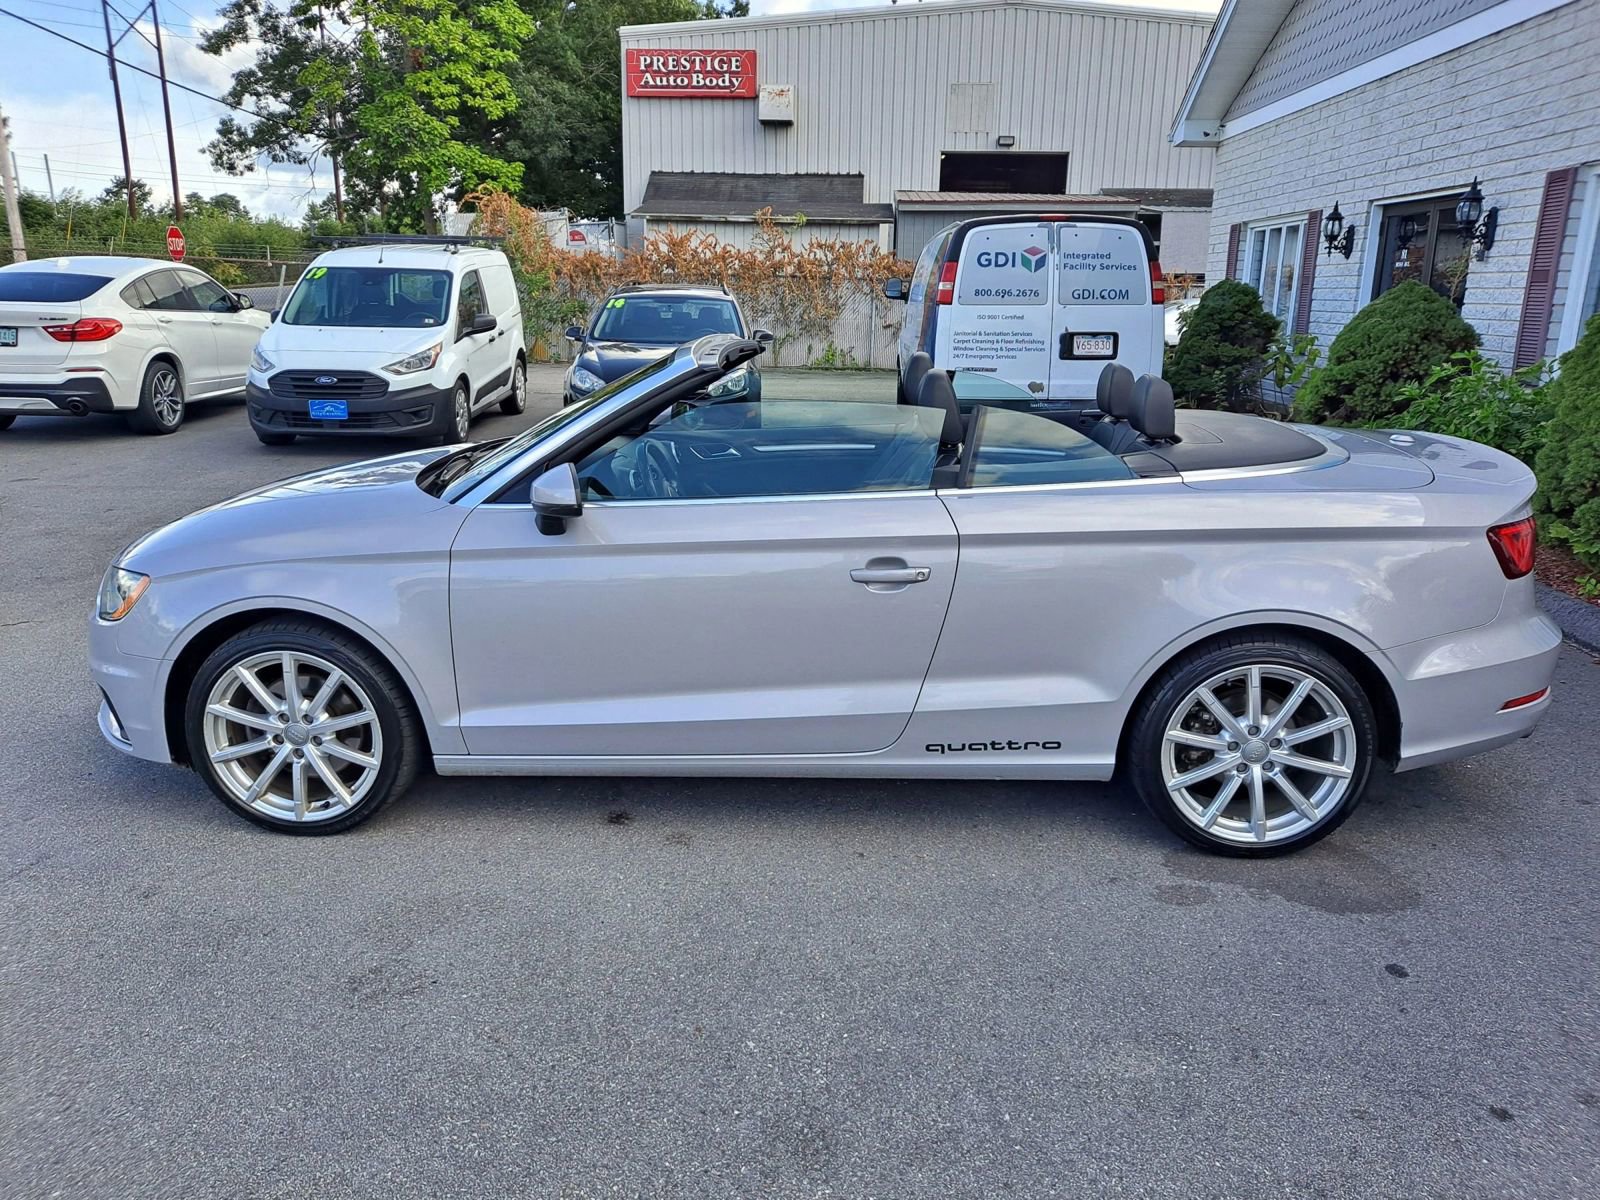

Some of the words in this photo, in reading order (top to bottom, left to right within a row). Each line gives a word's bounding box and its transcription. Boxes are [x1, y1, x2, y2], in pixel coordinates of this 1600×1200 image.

[639, 55, 742, 73] PRESTIGE
[640, 73, 689, 86] Auto
[691, 73, 743, 90] Body
[168, 237, 184, 250] STOP
[976, 251, 1016, 268] GDI
[1063, 252, 1111, 261] Integrated
[305, 267, 328, 279] 19
[1063, 263, 1098, 272] Facility
[1099, 263, 1137, 271] Services
[973, 288, 1040, 298] 800.696.2676
[1072, 288, 1130, 300] GDI.COM
[1075, 340, 1111, 350] V65-830
[924, 740, 1062, 755] quattro
